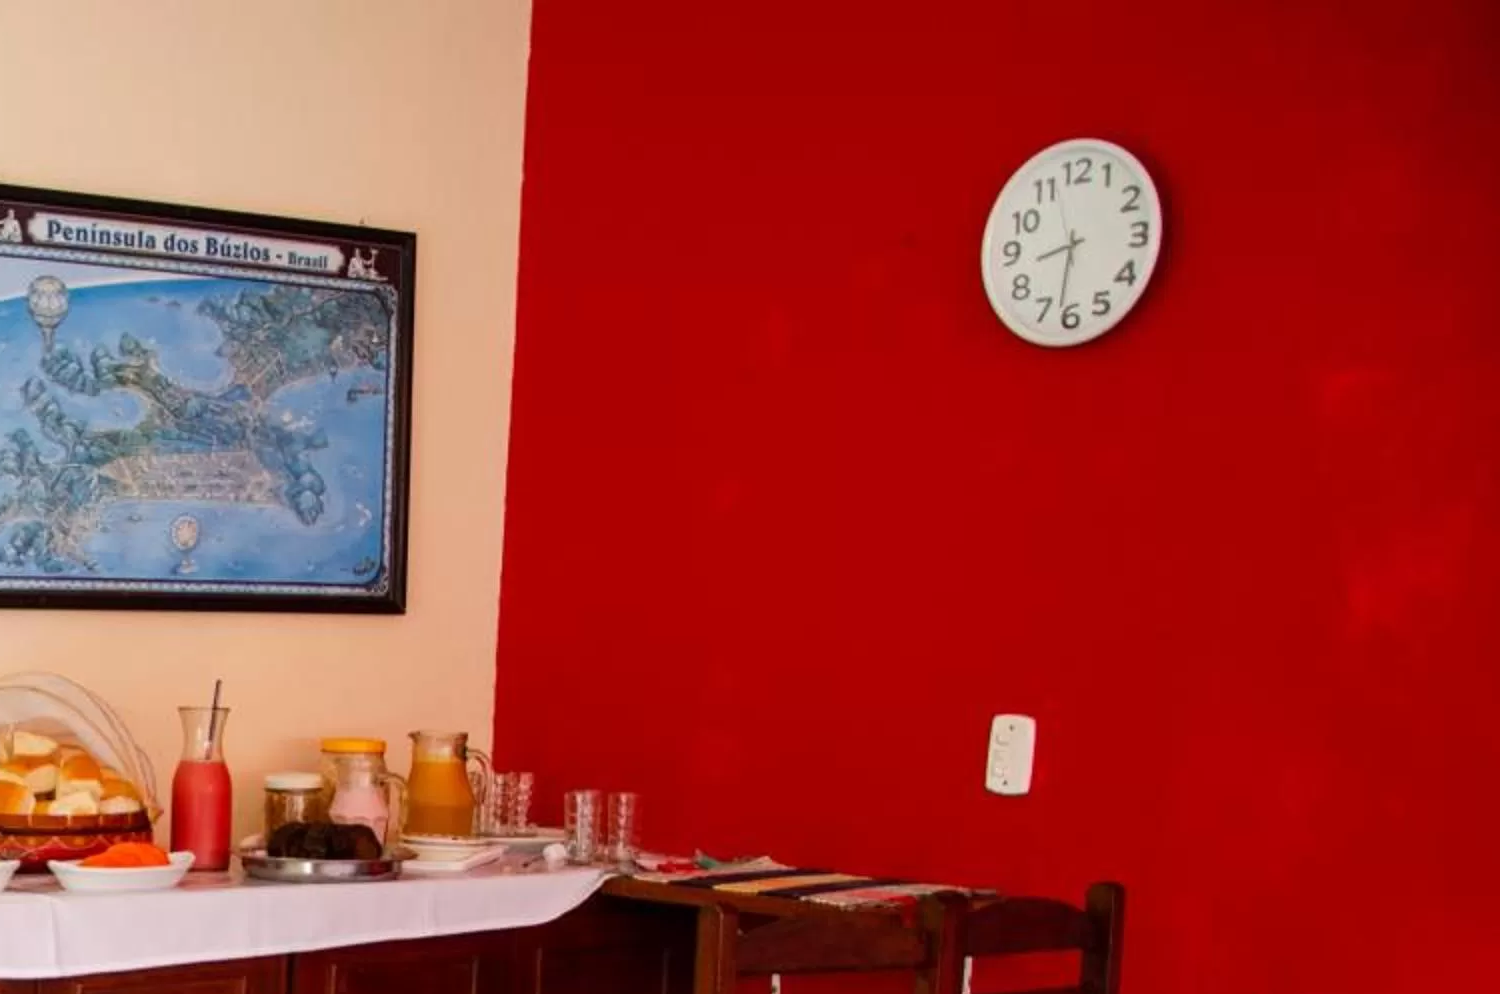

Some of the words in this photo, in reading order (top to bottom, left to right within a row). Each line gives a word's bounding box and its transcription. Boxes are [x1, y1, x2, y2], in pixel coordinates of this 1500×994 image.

[1061, 157, 1093, 186] 12
[1101, 162, 1112, 188] 1
[1033, 176, 1056, 204] 11
[1120, 184, 1141, 214] 2
[1011, 209, 1041, 235] 10
[1128, 221, 1150, 249] 3
[163, 233, 199, 254] dos
[204, 235, 271, 262] Búzios
[287, 251, 329, 269] Brasil
[1003, 240, 1022, 267] 9
[1011, 273, 1031, 301] 8
[1113, 259, 1137, 287] 4
[1036, 297, 1053, 324] 7
[1061, 303, 1081, 329] 6
[1091, 290, 1111, 316] 5
